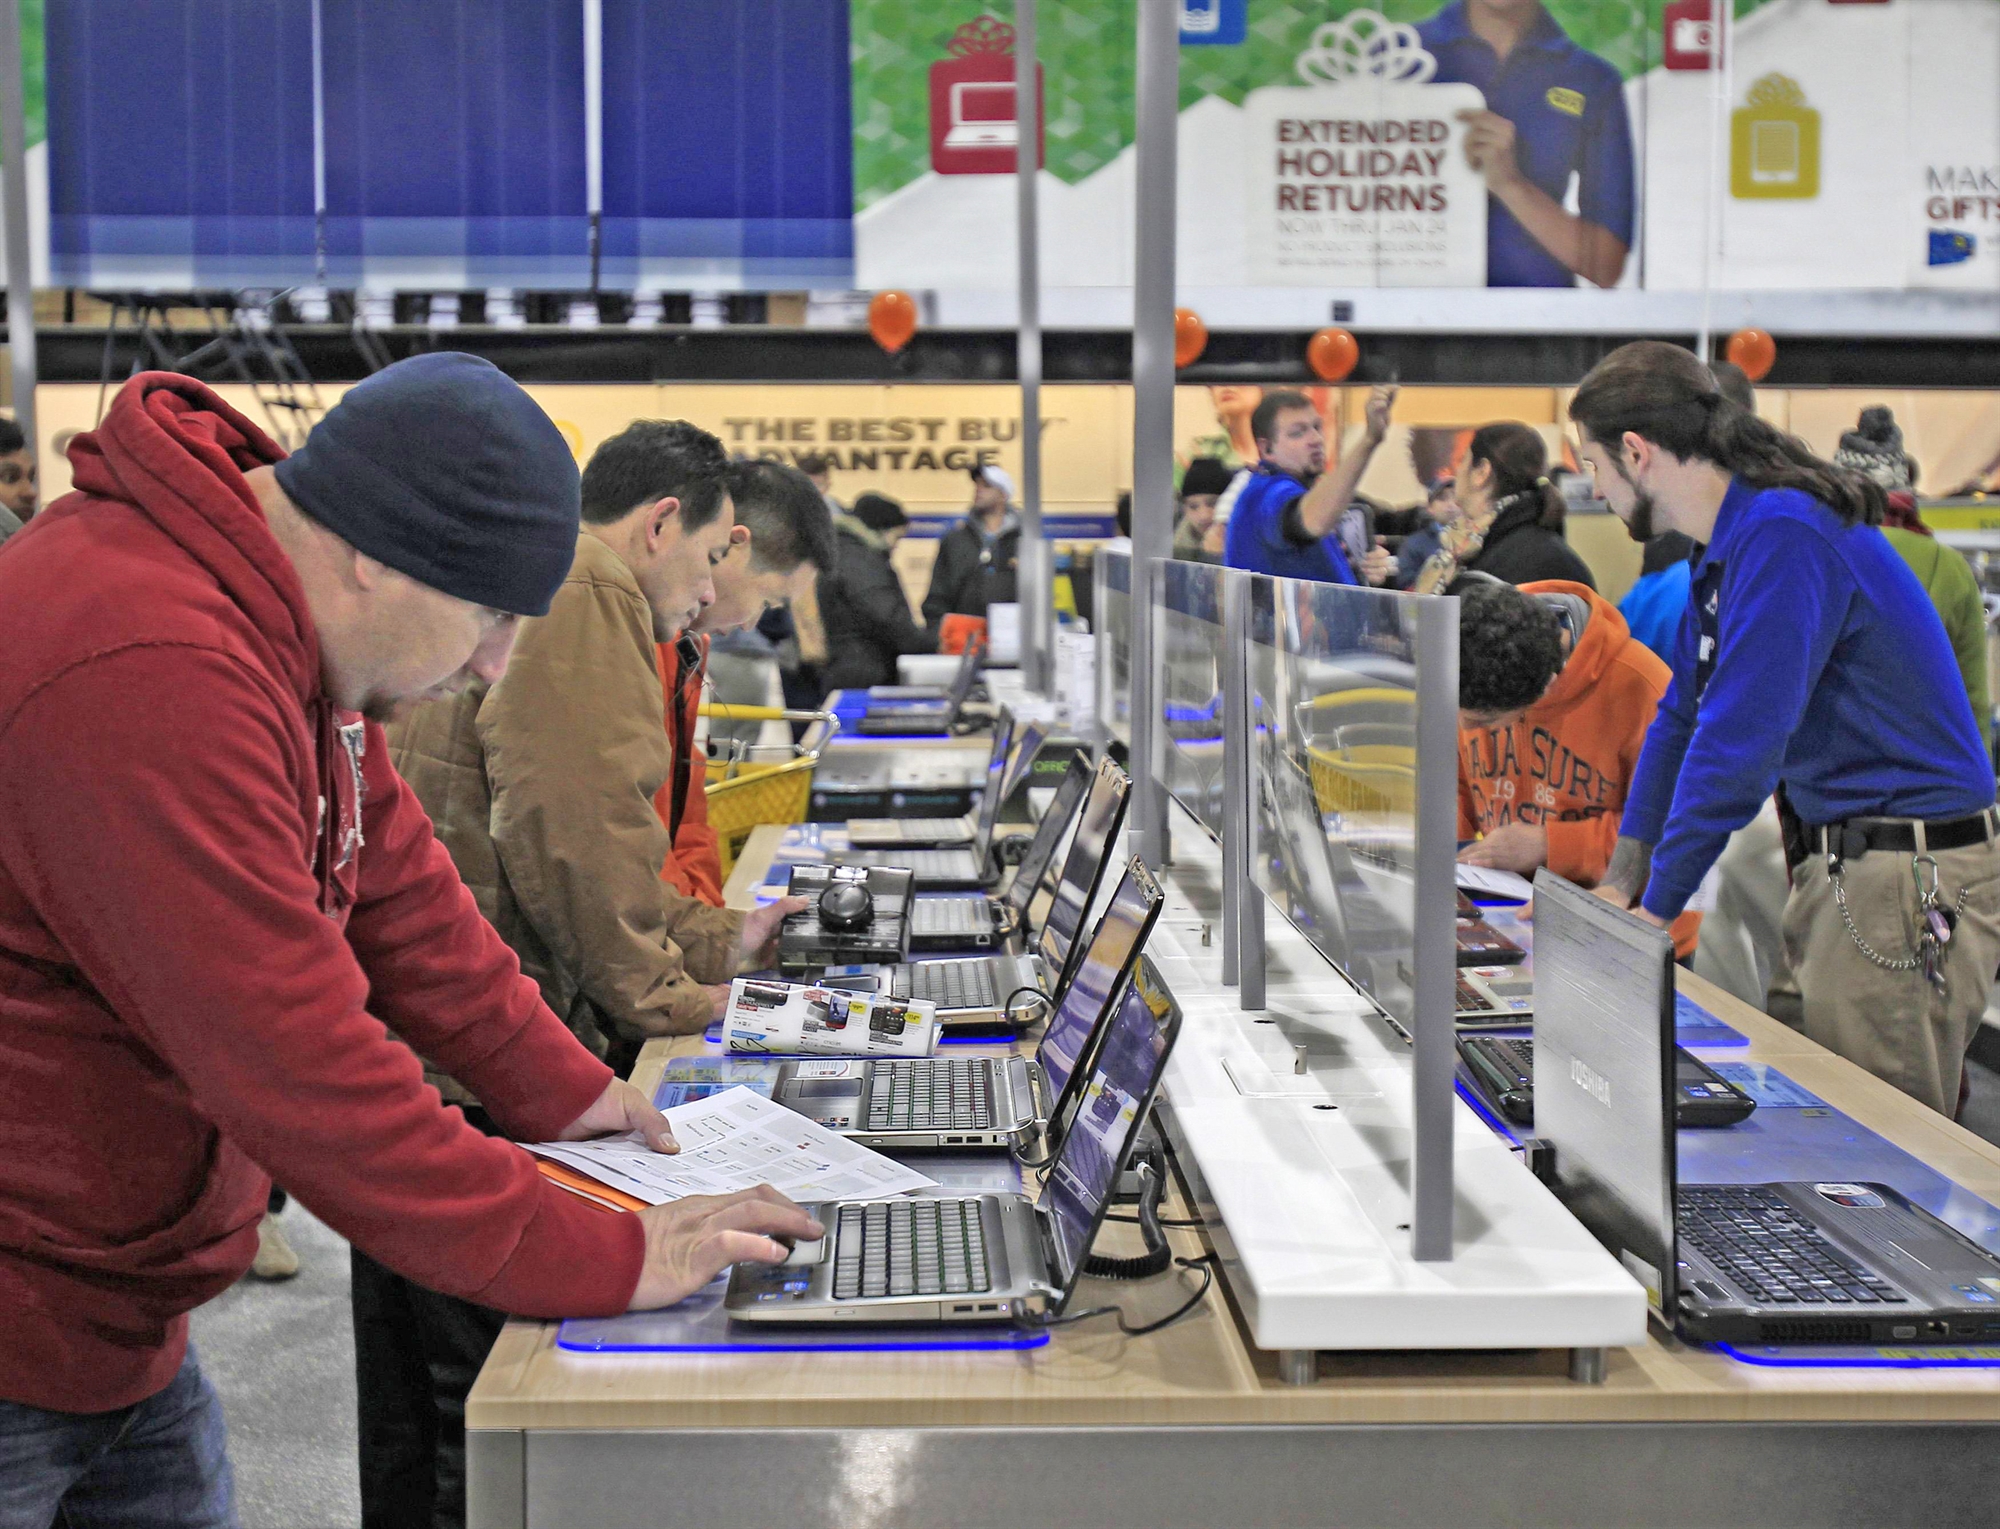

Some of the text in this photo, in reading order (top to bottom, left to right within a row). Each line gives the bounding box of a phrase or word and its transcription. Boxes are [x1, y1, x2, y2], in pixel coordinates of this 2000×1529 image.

[1278, 119, 1449, 142] EXTENDED
[1278, 149, 1446, 177] HOLIDAY
[1278, 184, 1448, 211] RETURNS
[724, 417, 816, 441] THE
[829, 417, 946, 441] BEST
[1464, 726, 1618, 803] AJA SURF
[1492, 777, 1556, 806] 19 86
[1571, 1056, 1611, 1108] TOSHIBA
